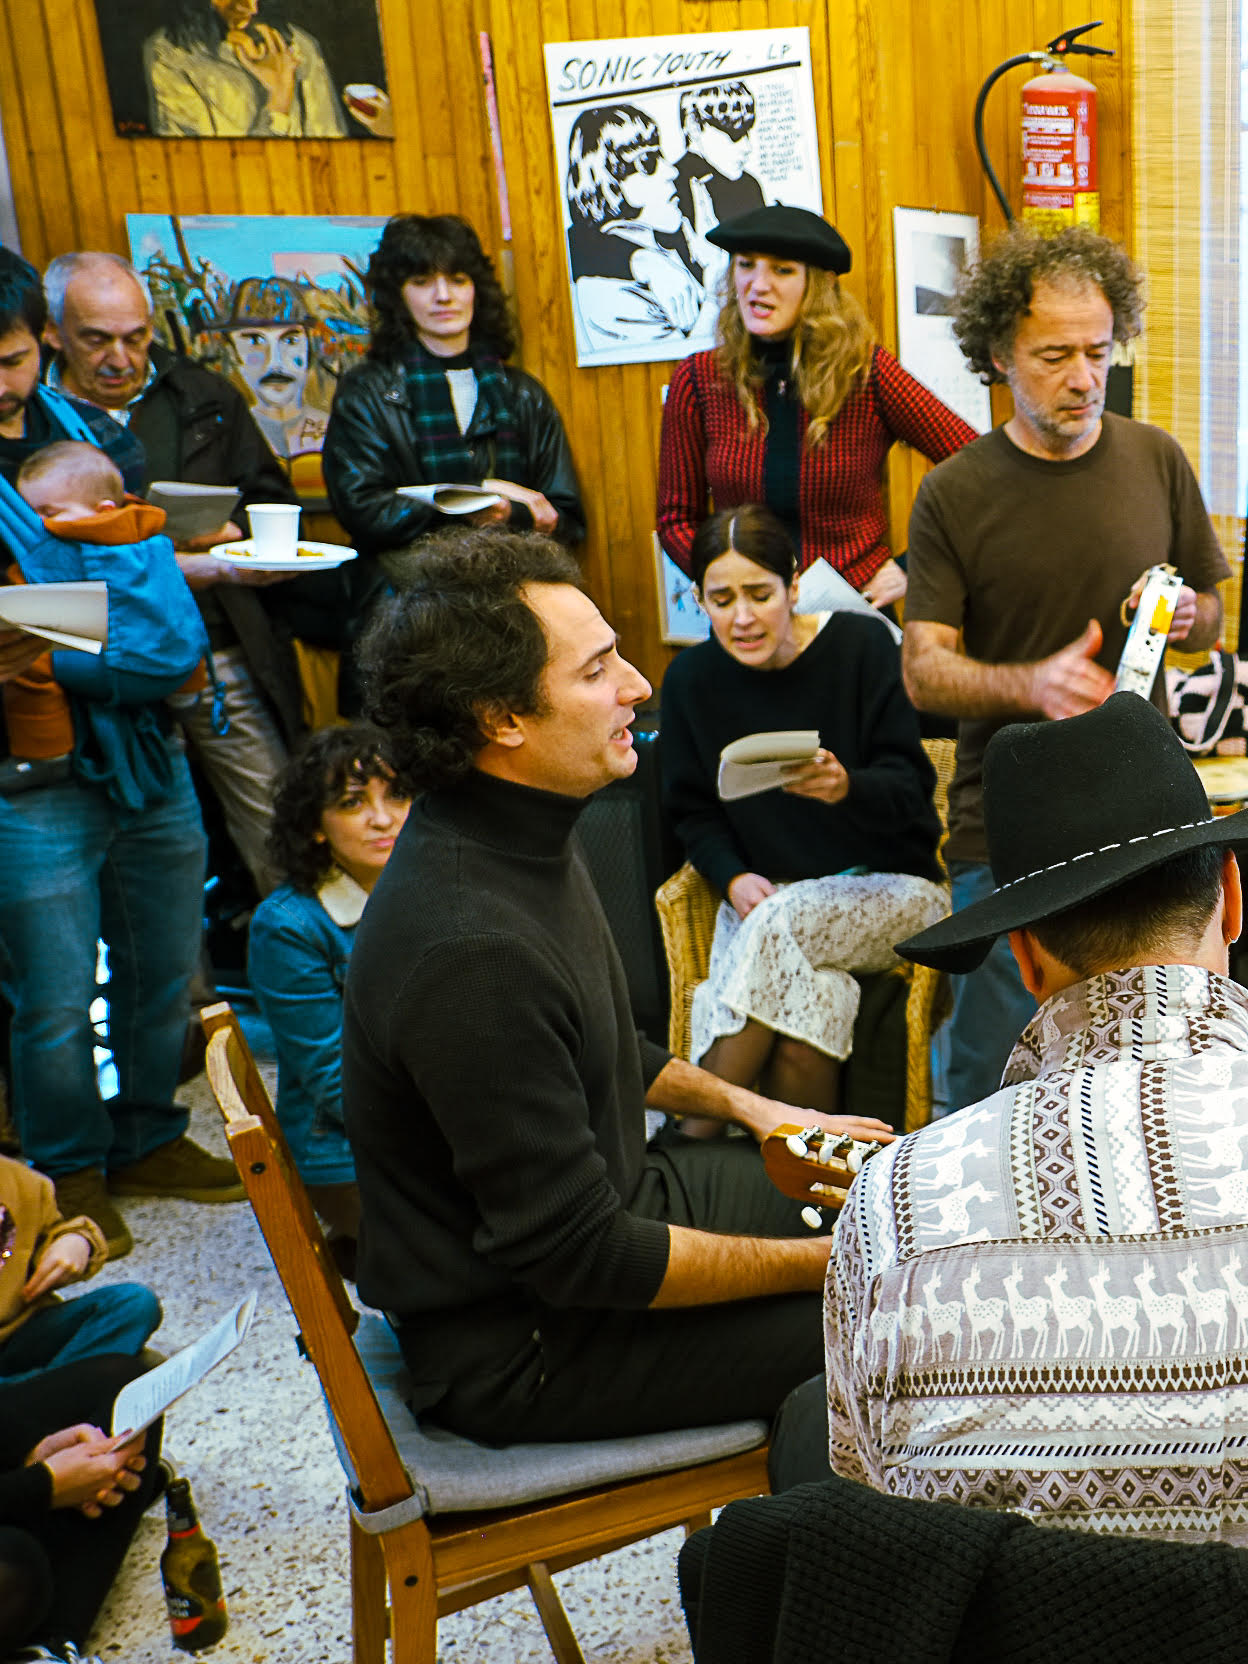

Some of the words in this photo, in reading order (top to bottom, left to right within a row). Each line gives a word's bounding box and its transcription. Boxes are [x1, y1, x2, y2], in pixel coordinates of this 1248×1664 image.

[558, 55, 646, 92] SONIC
[652, 50, 732, 78] YOUTH
[768, 43, 792, 60] LP
